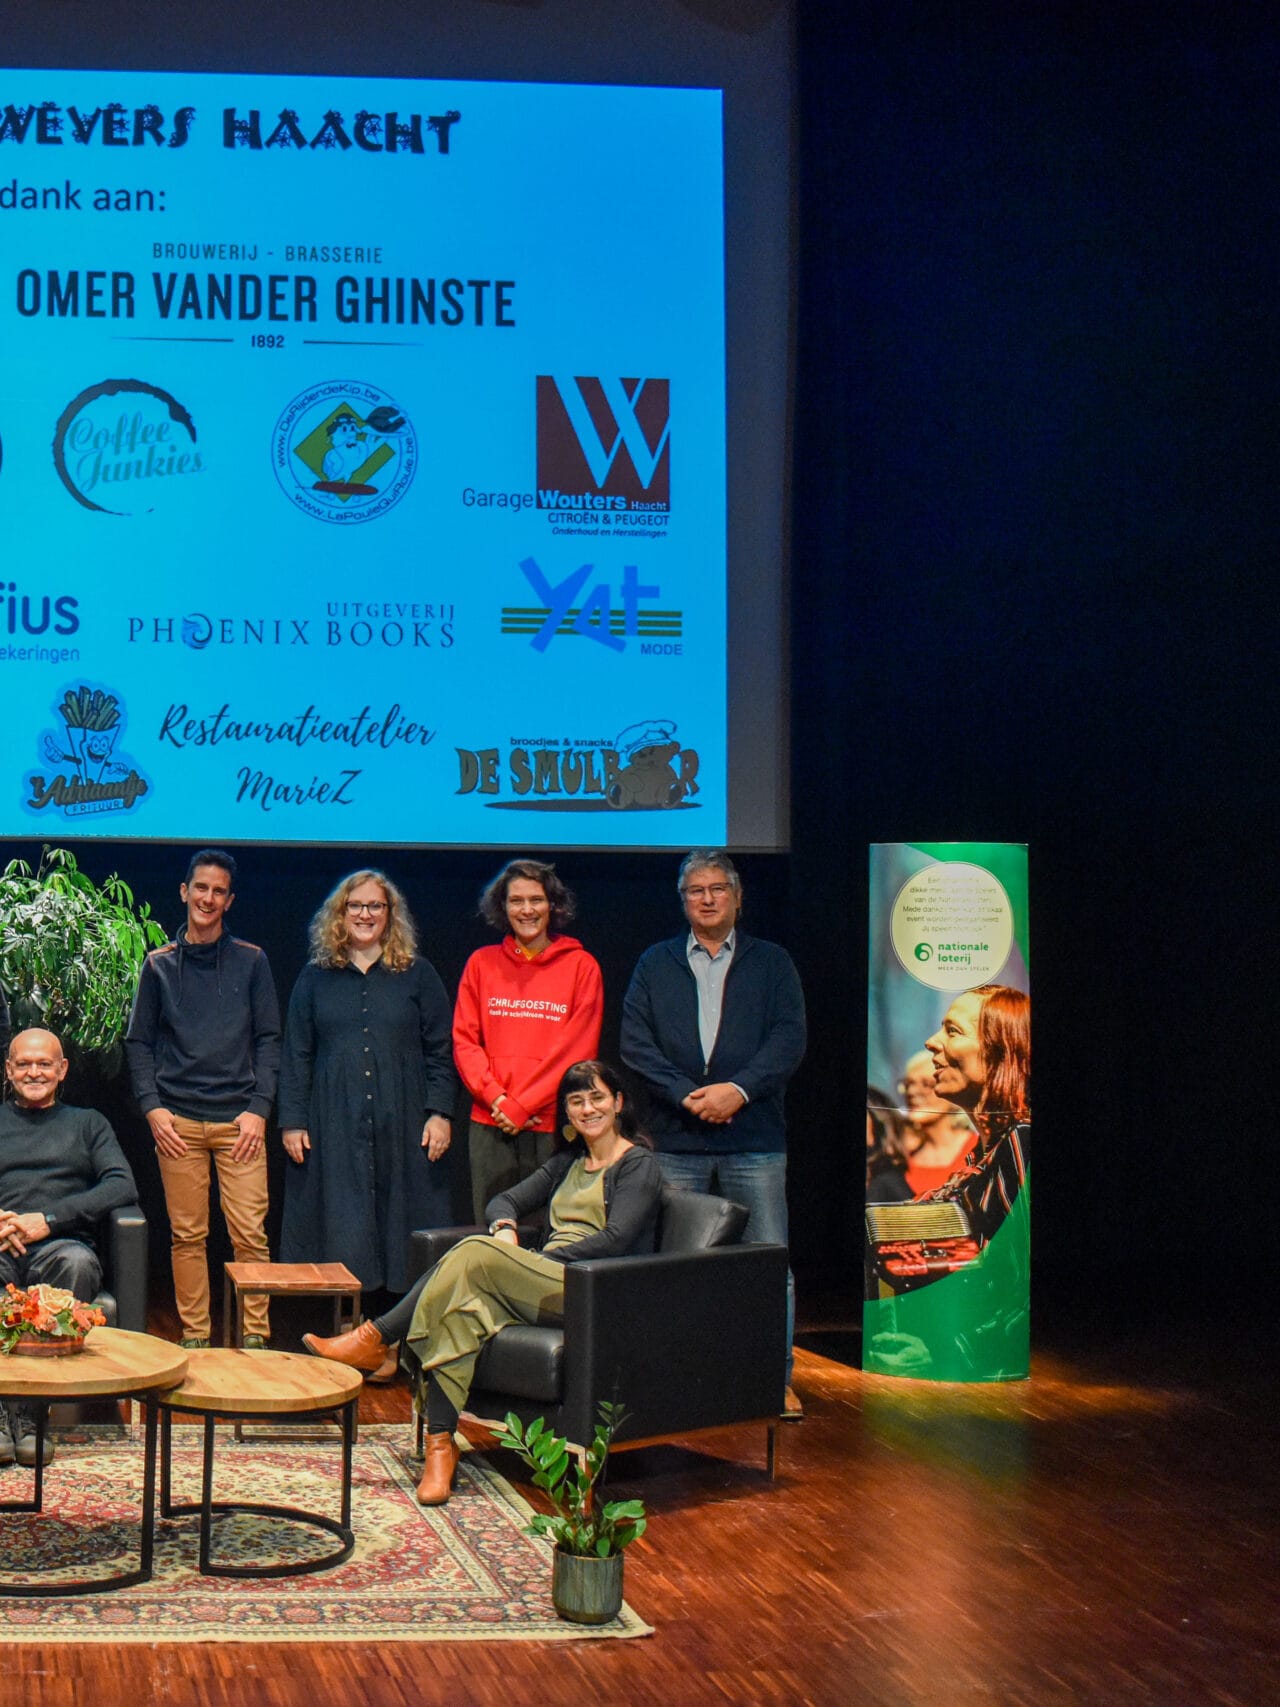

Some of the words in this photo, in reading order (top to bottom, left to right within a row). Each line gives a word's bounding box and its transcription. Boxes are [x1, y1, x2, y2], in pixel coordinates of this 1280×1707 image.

[223, 107, 462, 155] HAACHT
[92, 186, 167, 213] aan:
[152, 242, 258, 262] BROUWERIJ
[285, 246, 384, 264] BRASSERIE
[16, 268, 136, 318] OMER
[152, 272, 318, 323] VANDER
[335, 275, 517, 328] GHINSTE
[250, 334, 285, 349] 1892
[70, 411, 170, 456] Coffee
[77, 445, 207, 492] Junkies
[462, 488, 533, 512] Garage
[538, 490, 627, 510] Wouters
[631, 501, 667, 511] Haacht
[548, 511, 599, 525] CITROËN
[602, 514, 612, 525] &
[615, 514, 669, 526] PEUGEOT
[552, 526, 599, 536] Onderhoud
[601, 529, 610, 537] en
[613, 528, 667, 538] Herstellingen
[326, 601, 455, 619] UITGEVERIJ
[326, 620, 455, 649] BOOKS
[640, 643, 683, 656] MODE
[159, 703, 437, 749] Restauratieatelier
[510, 737, 559, 747] broodjes
[563, 738, 571, 747] &
[574, 738, 613, 747] snacks
[454, 747, 500, 795] DE
[236, 766, 362, 811] MarieZ
[938, 942, 989, 951] nationale
[938, 954, 971, 964] loterij
